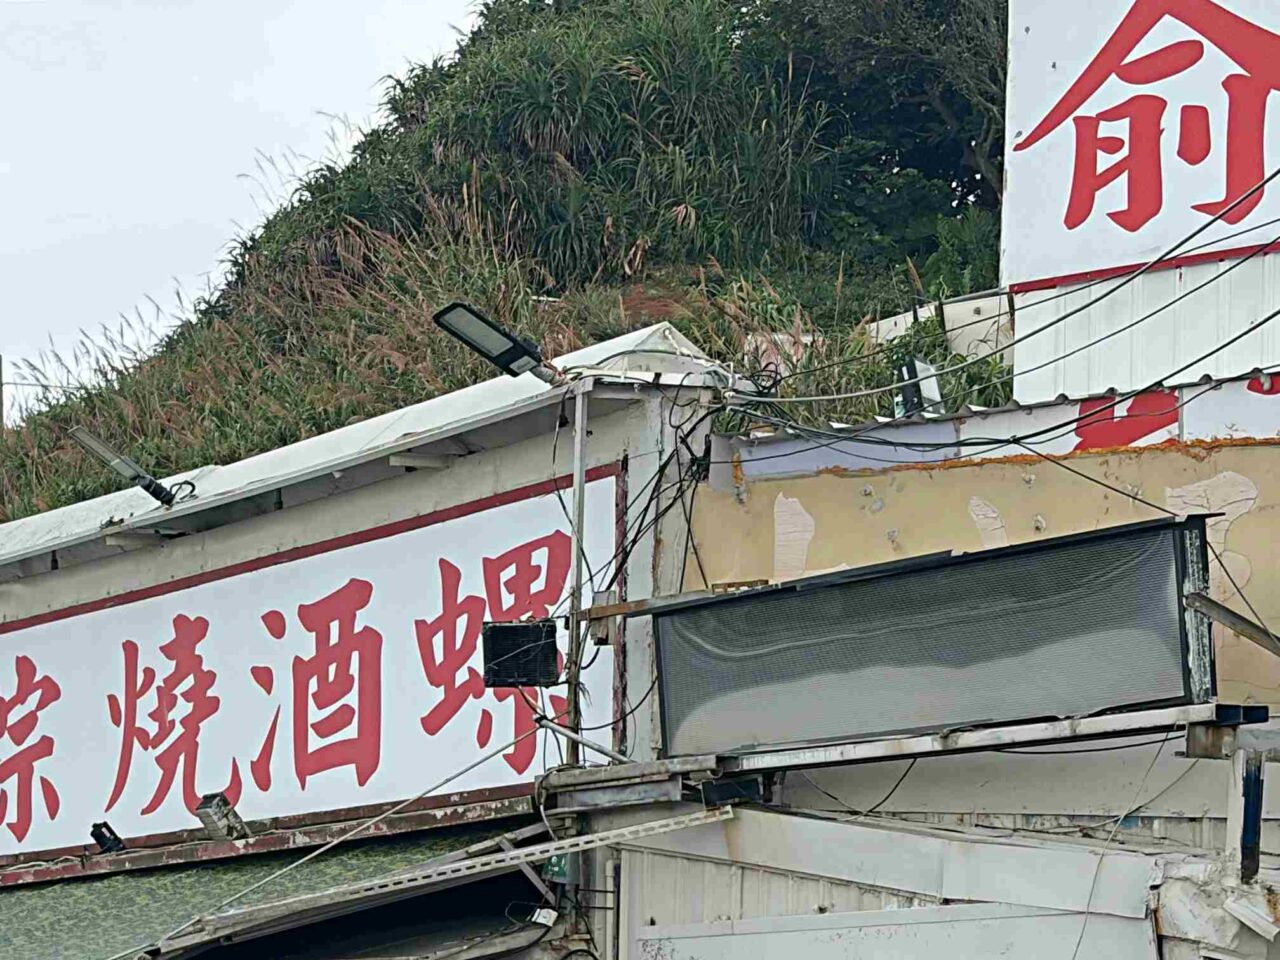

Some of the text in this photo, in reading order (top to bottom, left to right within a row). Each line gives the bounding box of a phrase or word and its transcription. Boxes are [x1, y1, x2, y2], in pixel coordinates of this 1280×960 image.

[1013, 0, 1280, 233] 俞
[104, 529, 573, 818] 燒酒螺
